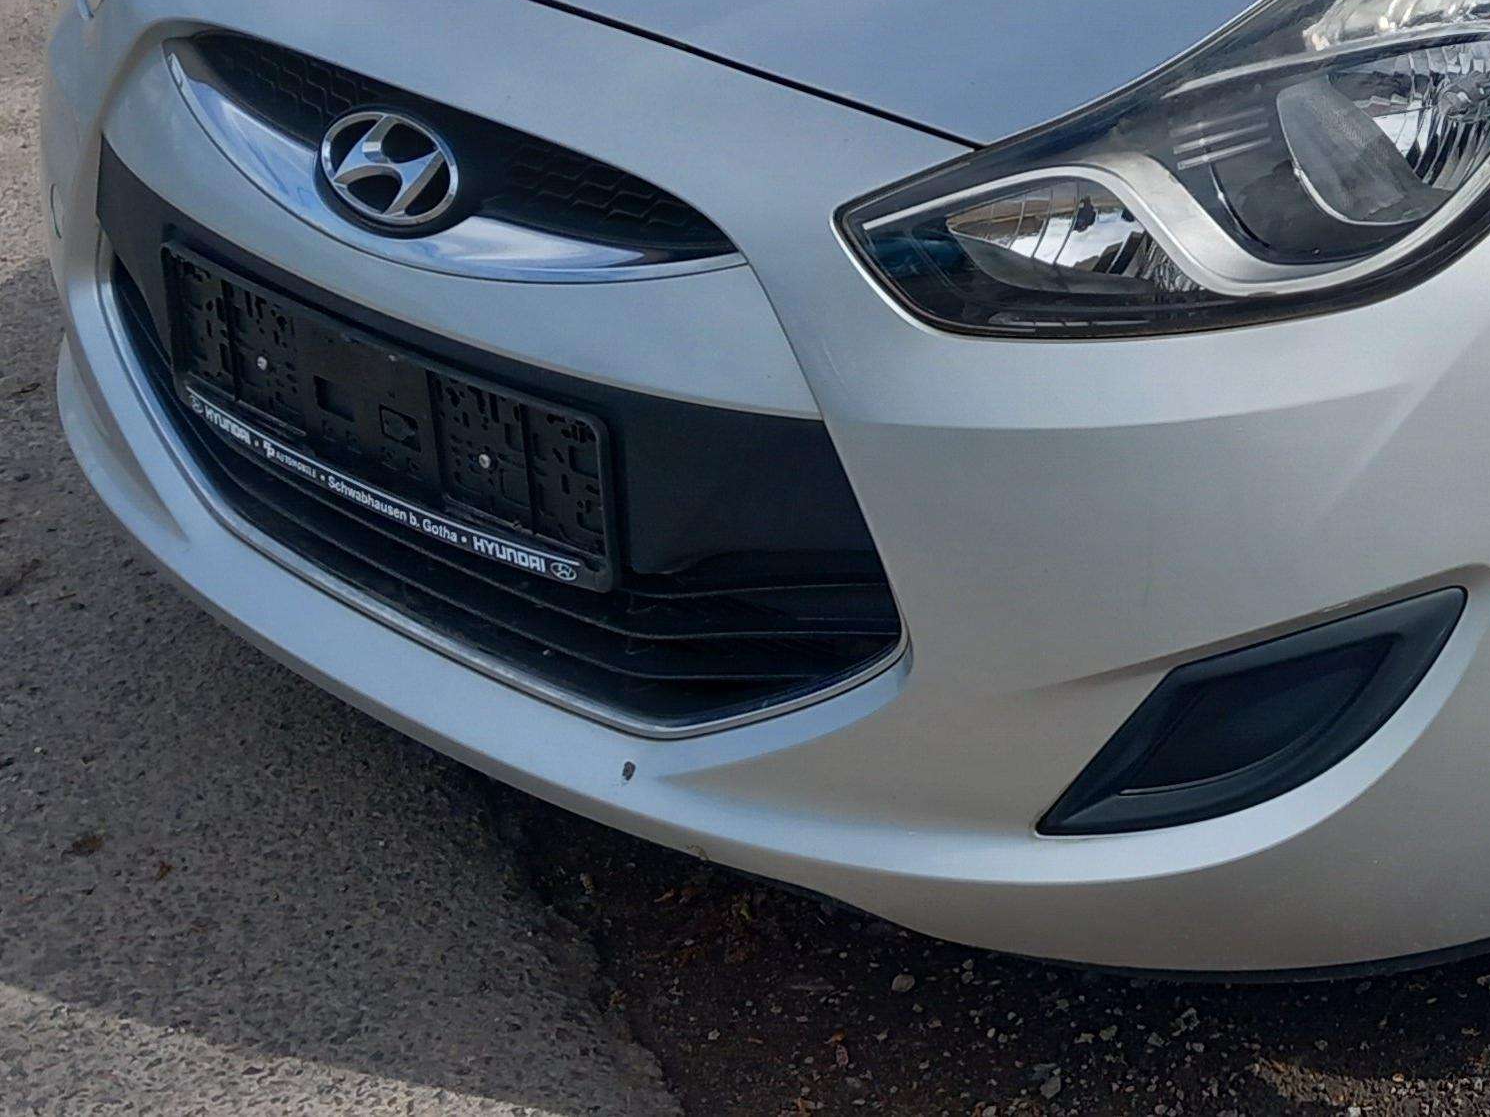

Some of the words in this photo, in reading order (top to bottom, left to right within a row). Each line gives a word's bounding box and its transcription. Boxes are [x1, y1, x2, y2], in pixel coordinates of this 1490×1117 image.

[204, 404, 251, 445] HYUNDAI
[328, 475, 408, 522] Schwabhausen
[409, 512, 421, 529] b.
[422, 518, 458, 543] Gotha
[473, 536, 546, 573] HYUNDAI
